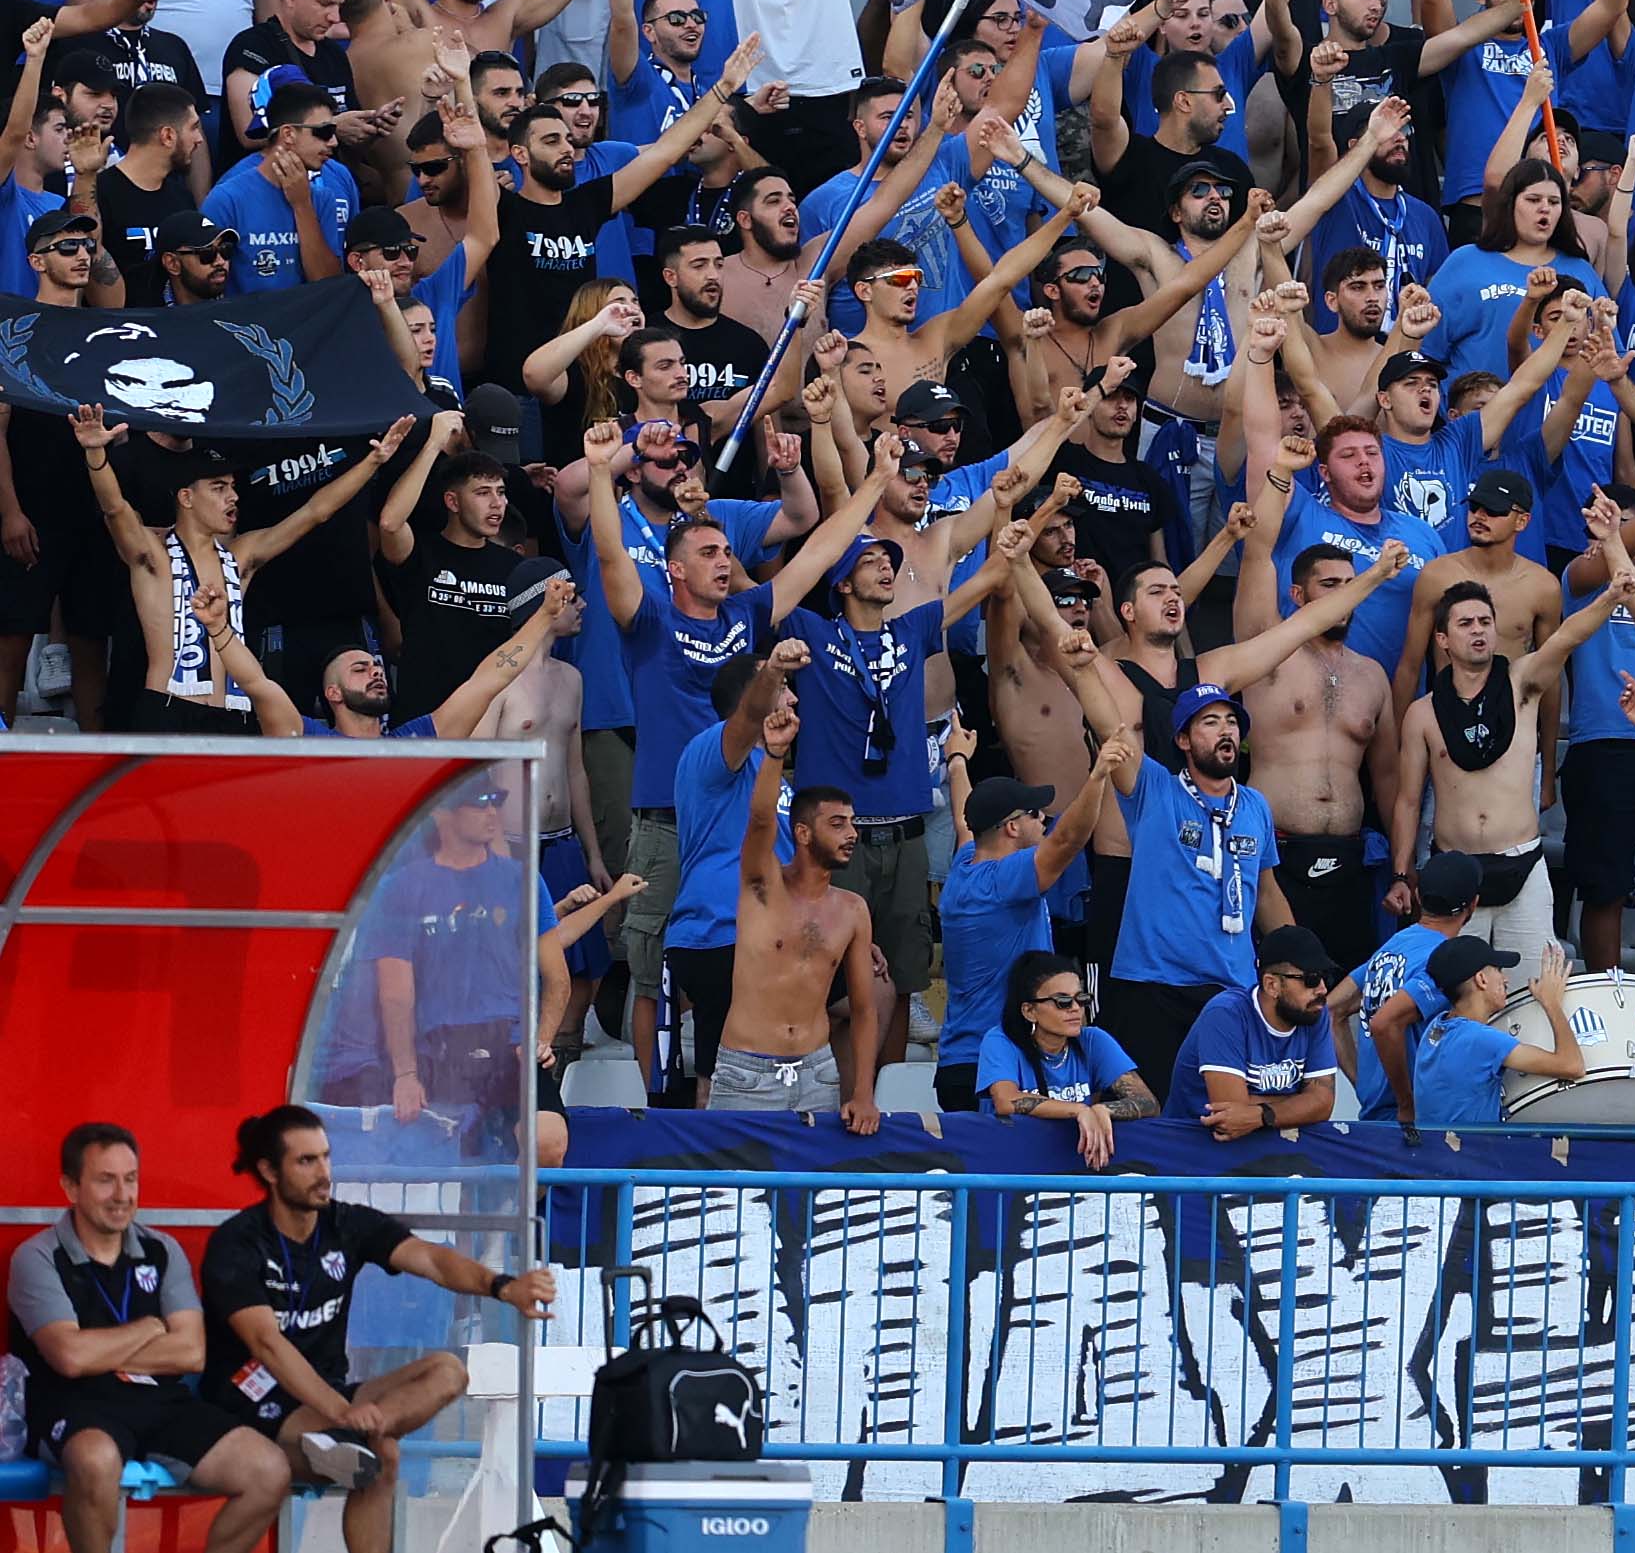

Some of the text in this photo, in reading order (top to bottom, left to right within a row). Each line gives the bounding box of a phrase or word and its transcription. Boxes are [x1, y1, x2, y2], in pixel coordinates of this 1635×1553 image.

[249, 233, 298, 246] MAXH
[530, 233, 584, 259] 1994
[267, 443, 331, 486] 1994
[1315, 858, 1338, 870] NIKE
[701, 1517, 769, 1535] IGLOO
